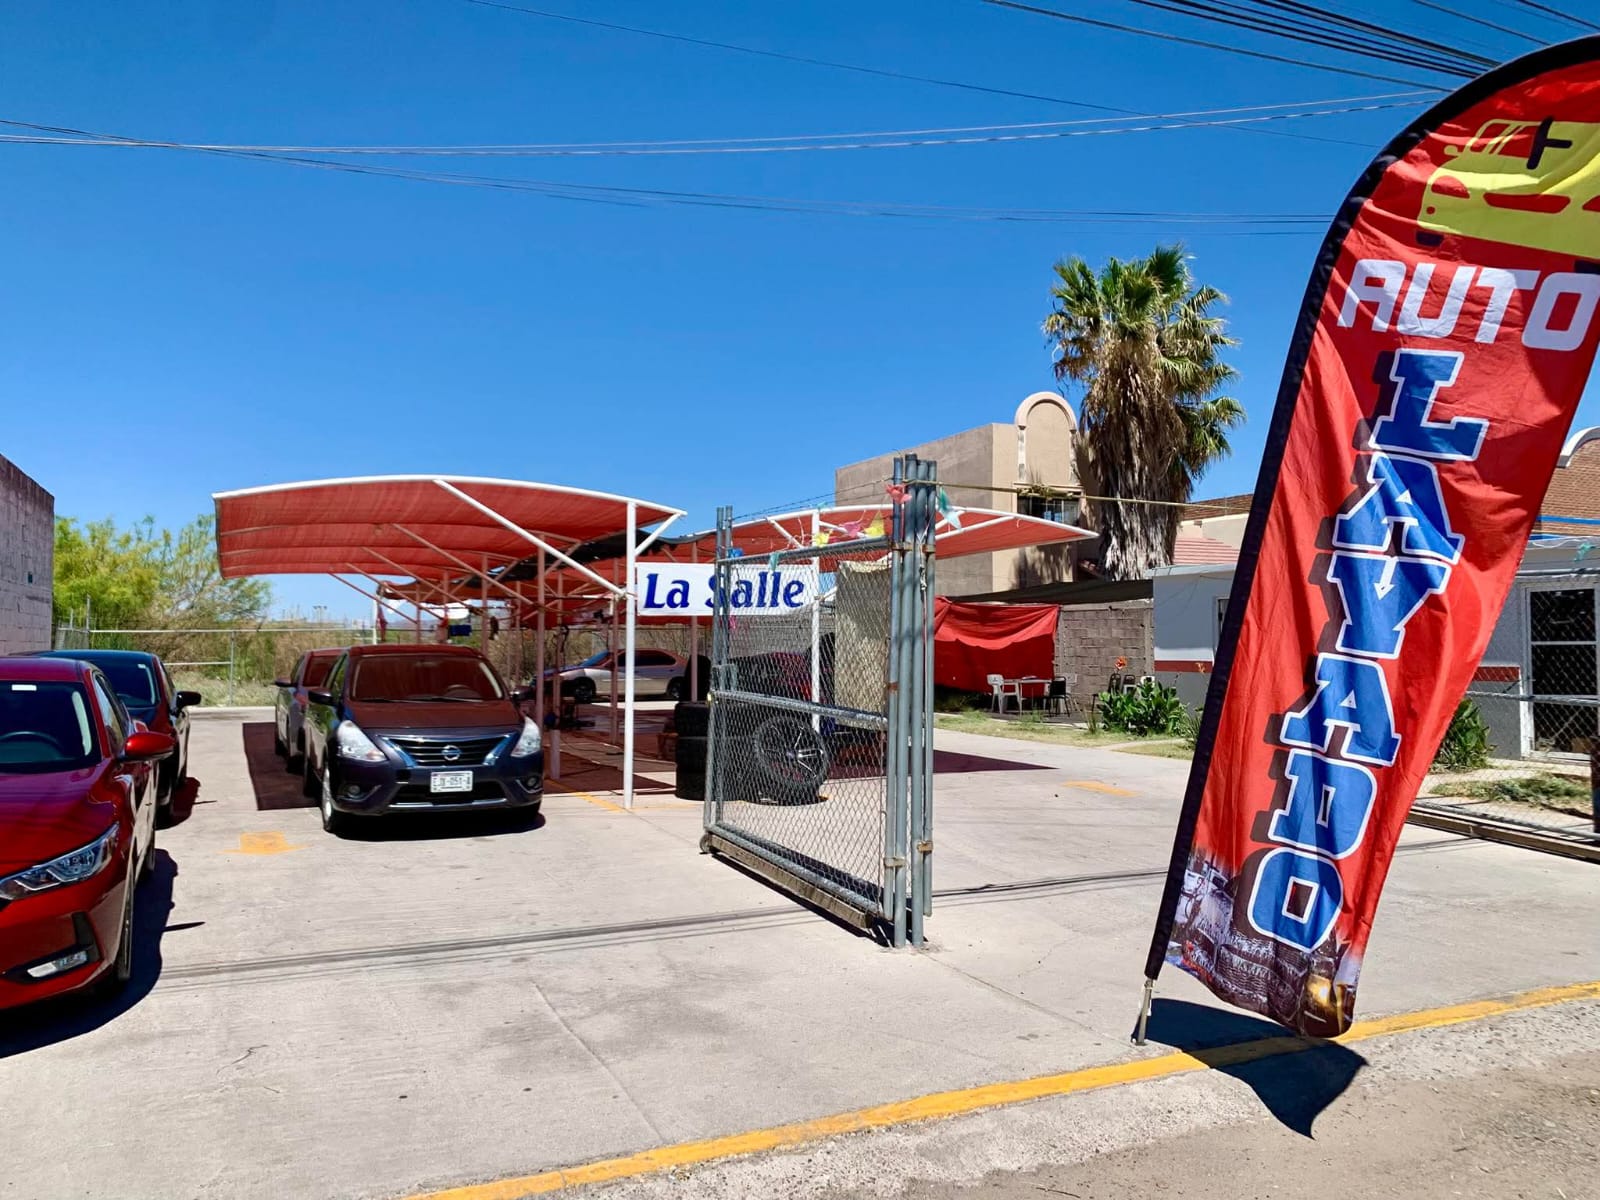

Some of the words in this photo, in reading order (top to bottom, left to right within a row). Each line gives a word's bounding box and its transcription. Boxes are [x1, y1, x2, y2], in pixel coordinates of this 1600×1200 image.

[1337, 259, 1600, 351] AUTO
[643, 573, 690, 609] La
[1247, 348, 1490, 954] LAVADO
